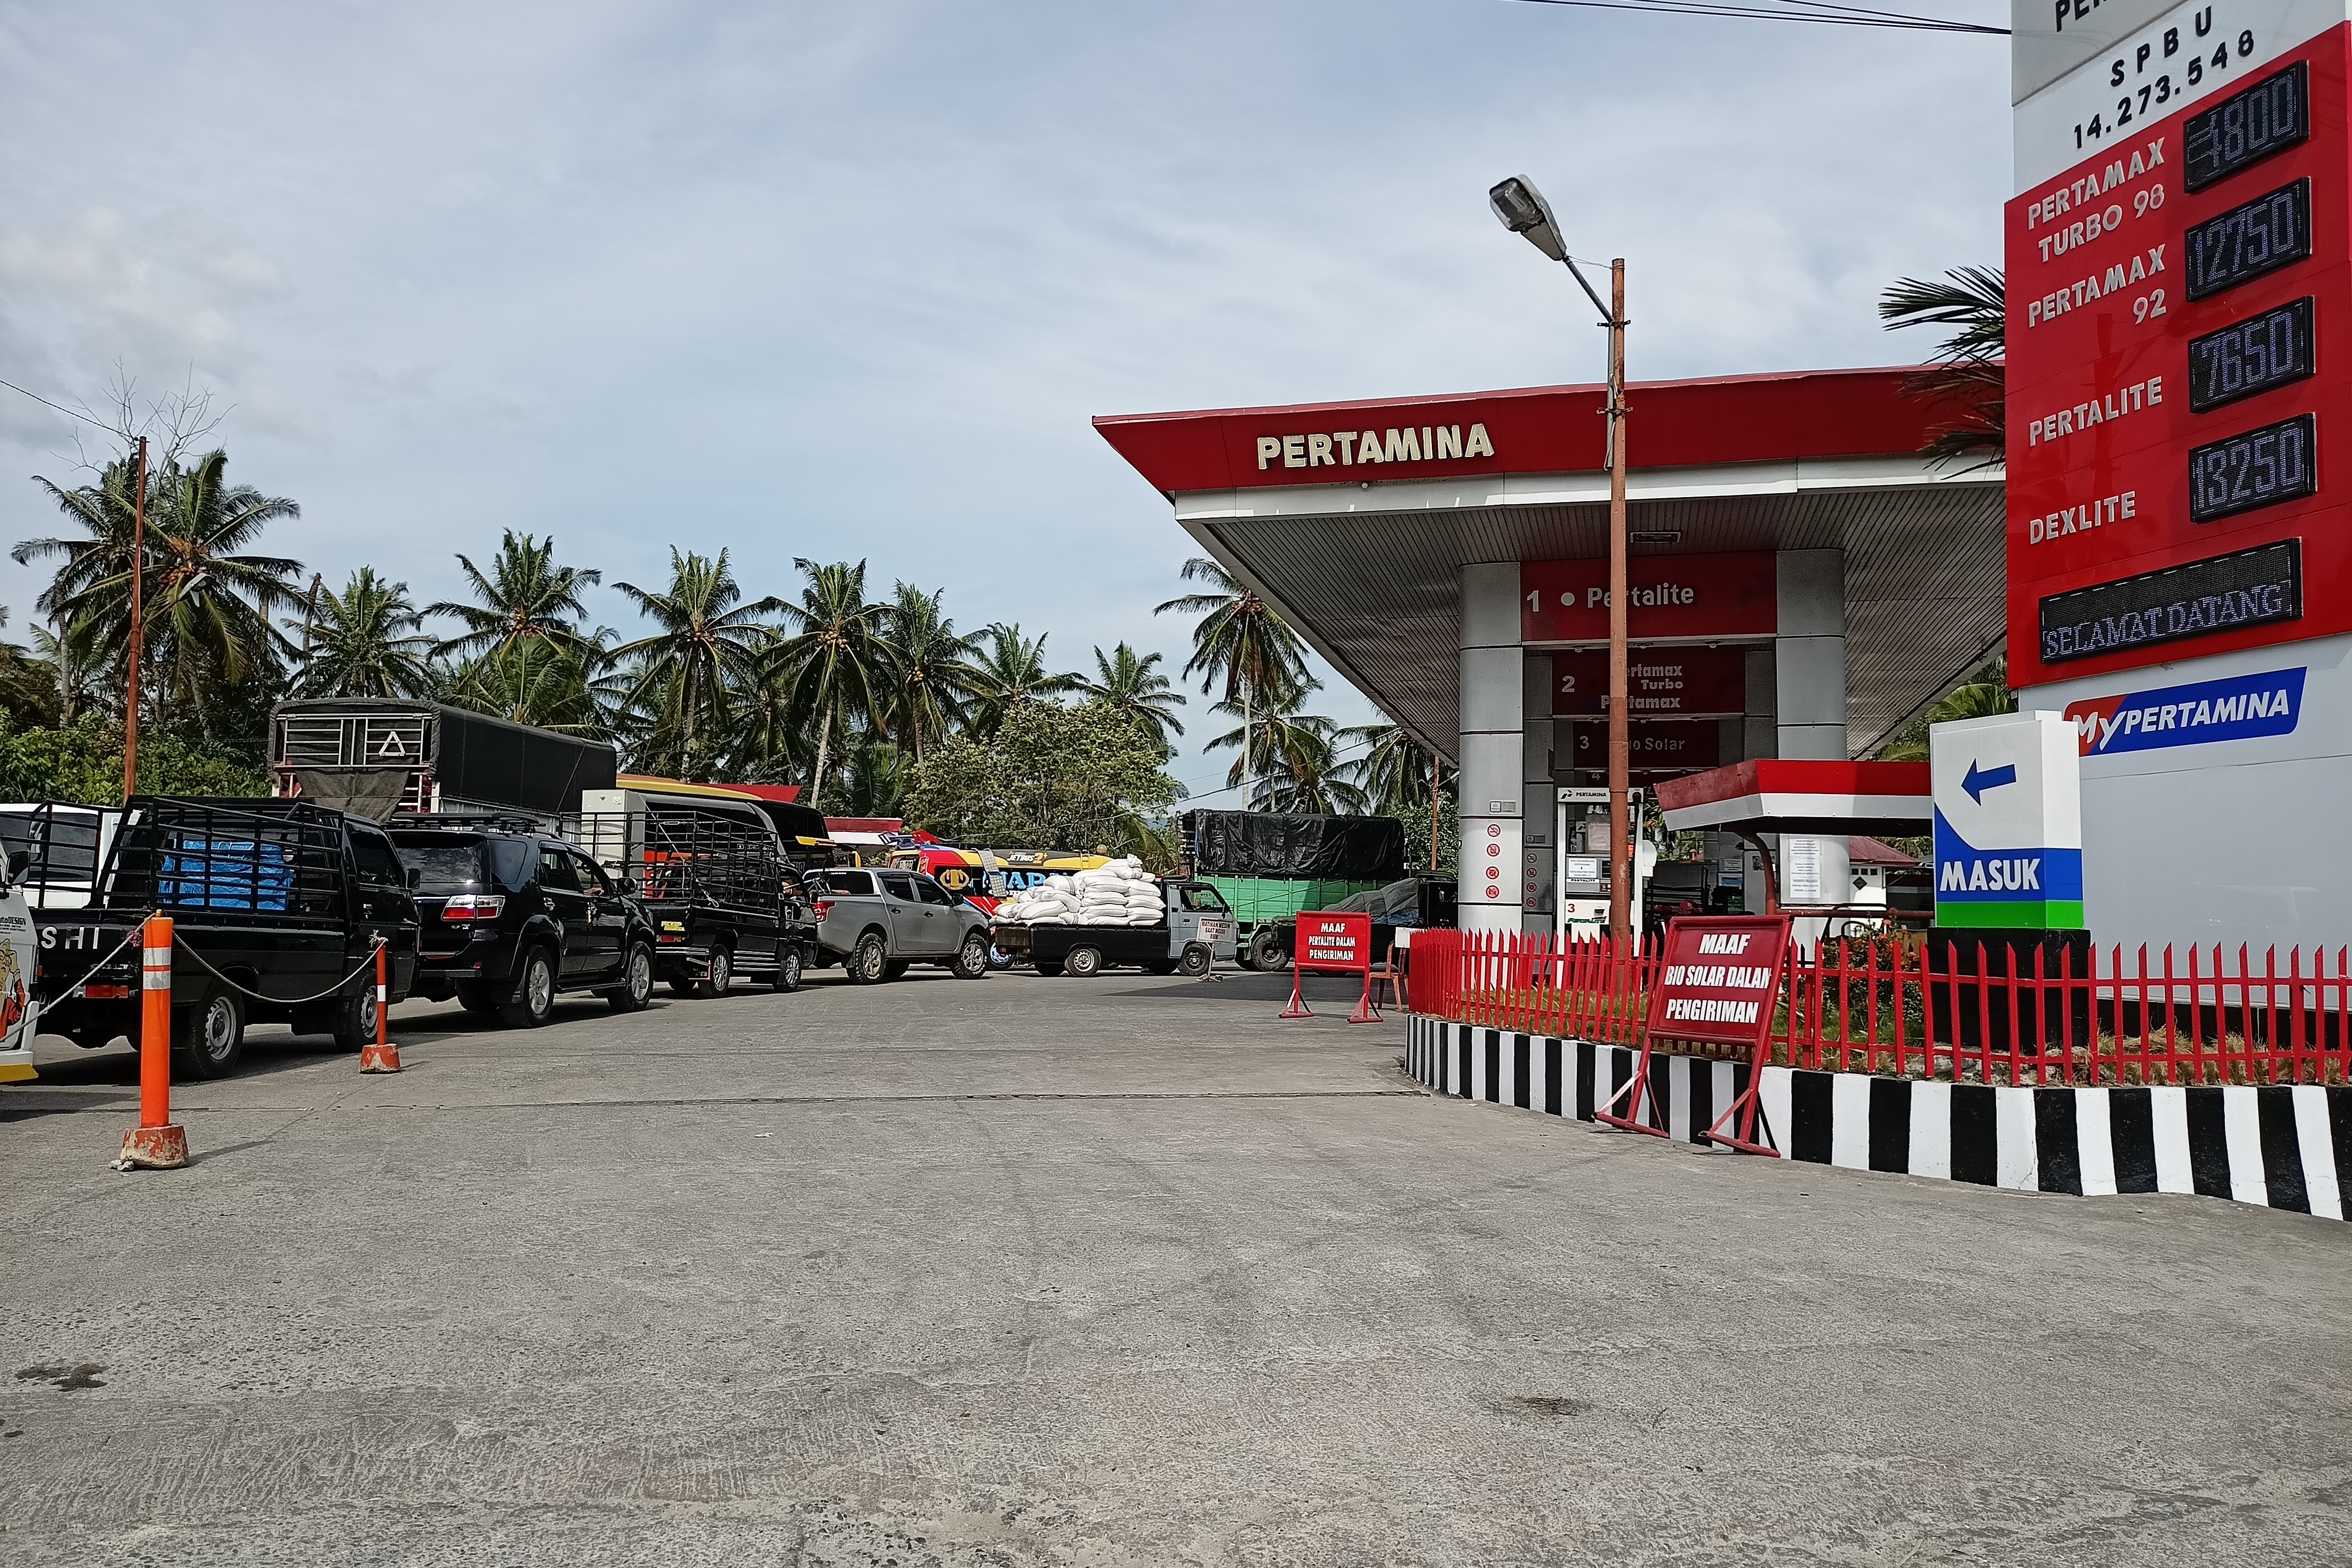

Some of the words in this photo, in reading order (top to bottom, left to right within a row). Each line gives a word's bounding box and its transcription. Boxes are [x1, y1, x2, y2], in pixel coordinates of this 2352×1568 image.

[2074, 29, 2254, 149] 14.273.548
[2028, 137, 2165, 230] PERTAMAX
[2039, 205, 2123, 262] TURBO
[2134, 184, 2165, 219] 98
[2196, 193, 2294, 286] 12750
[2028, 243, 2165, 328] PERTAMAX
[2133, 288, 2167, 326] 92
[2201, 312, 2293, 398] 7650
[2029, 376, 2163, 447] PERTALITE
[1257, 423, 1495, 470] PERTAMINA
[2196, 428, 2305, 511] 13250
[2030, 491, 2136, 545] DEXLITE
[1527, 590, 1539, 612] 1
[1587, 582, 1695, 608] Petalite
[2046, 606, 2171, 656] SELAMAT
[2168, 584, 2283, 632] DATANG
[1561, 676, 1575, 693] 2
[1641, 678, 1683, 690] Turbo
[1601, 695, 1681, 708] Ptamax
[1579, 735, 1589, 749] 3
[1645, 738, 1685, 750] Solar
[1940, 858, 2042, 892] MASUK
[1567, 903, 1576, 913] 3
[1320, 923, 1345, 933] MAAF
[1309, 936, 1335, 947] PERTALITE
[1335, 937, 1356, 947] DALAM
[1698, 934, 1751, 954] MAAF
[1309, 949, 1354, 961] PENGIRIMAN
[1664, 965, 1686, 986] BIO
[1685, 966, 1726, 987] SOLAR
[1665, 999, 1760, 1024] PENGIRIMAN
